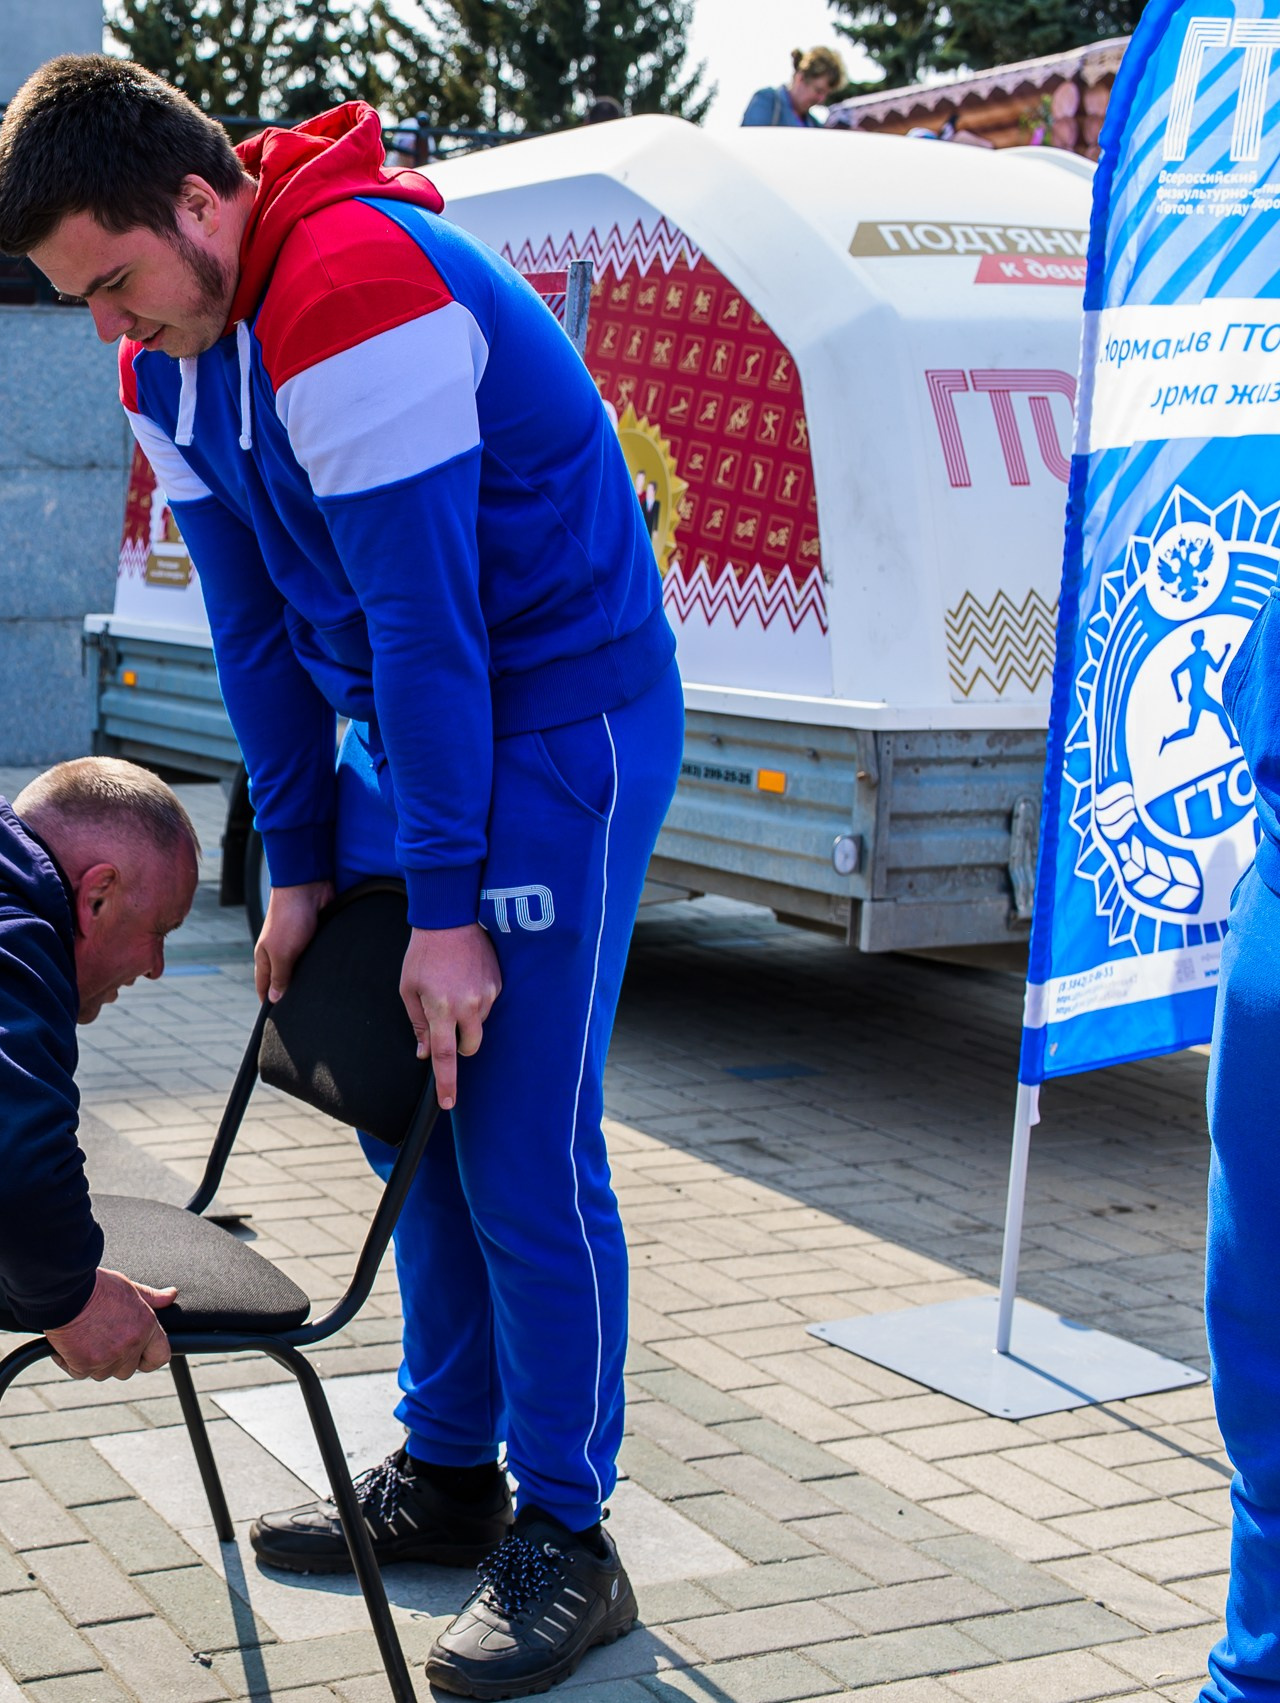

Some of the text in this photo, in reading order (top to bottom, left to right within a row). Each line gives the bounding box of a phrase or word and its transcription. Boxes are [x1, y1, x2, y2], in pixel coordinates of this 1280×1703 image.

[1158, 169, 1258, 187] Всероссийский
[1208, 203, 1250, 217] труду
[1024, 258, 1088, 281] дви
[1173, 759, 1257, 837] ГТО
[480, 884, 556, 933] ТО
